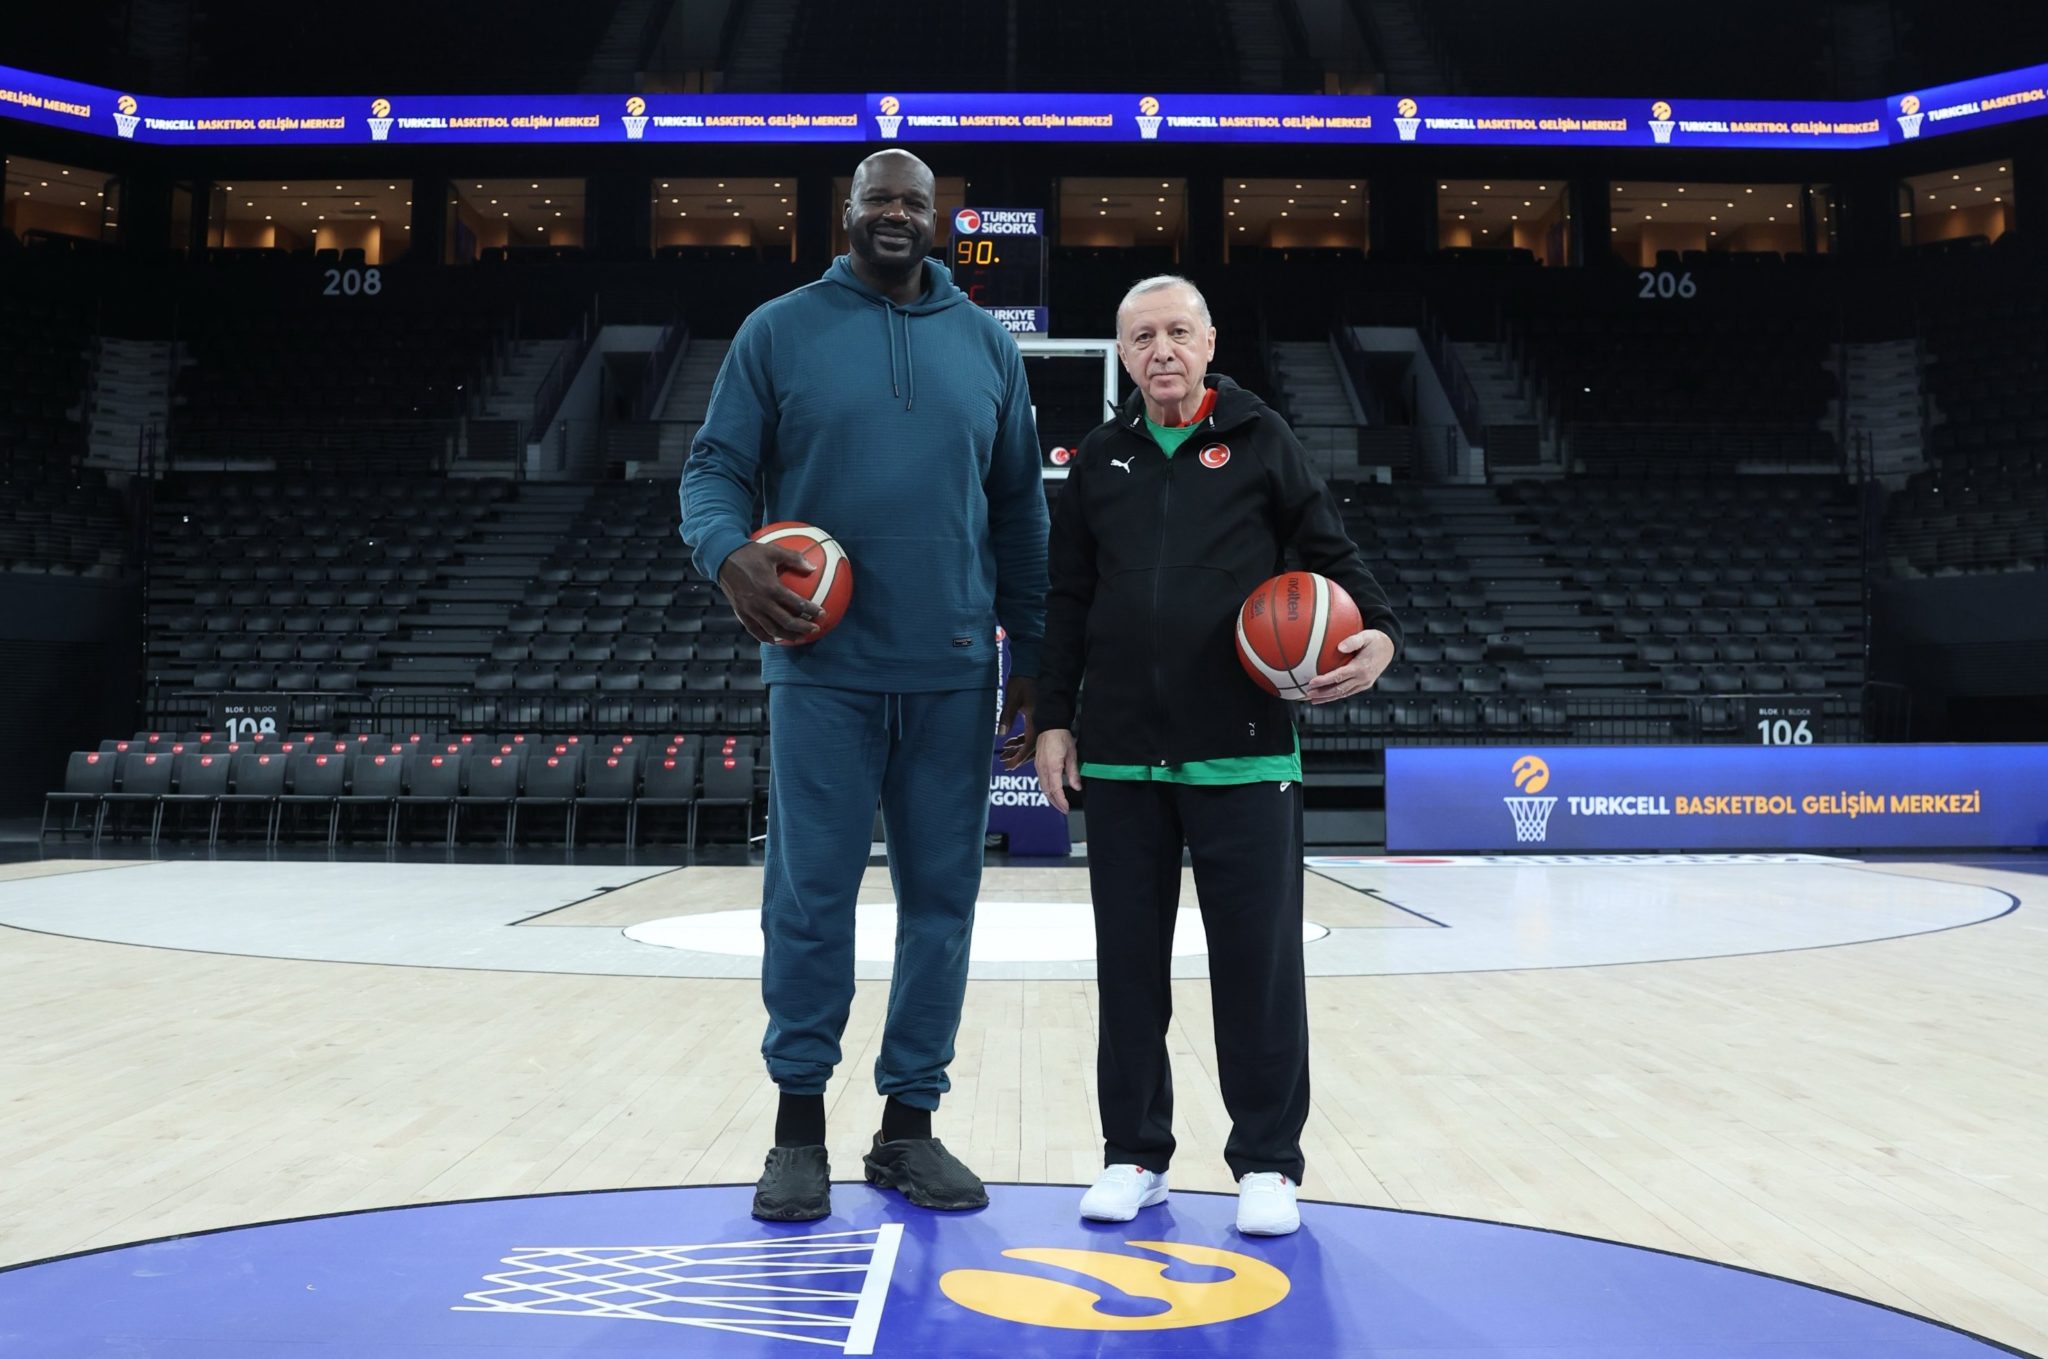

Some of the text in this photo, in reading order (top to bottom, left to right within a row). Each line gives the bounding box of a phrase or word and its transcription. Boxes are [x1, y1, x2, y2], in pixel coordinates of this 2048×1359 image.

[43, 98, 91, 118] MERKEZİ
[1926, 88, 2046, 122] TURKCELL BASKETBOL
[144, 117, 195, 130] TURKCELL
[197, 118, 256, 130] BASKETBOL
[300, 116, 345, 130] MERKEZİ
[397, 117, 448, 129] TURKCELL
[449, 117, 509, 128] BASKETBOL
[553, 115, 600, 128] MERKEZİ
[652, 115, 704, 127] TURKCELL
[705, 115, 766, 127] BASKETBOL
[811, 114, 857, 127] MERKEZİ
[907, 115, 959, 127] TURKCELL
[960, 115, 1021, 127] BASKETBOL
[1066, 114, 1113, 127] MERKEZİ
[1167, 116, 1219, 128] TURKCELL
[1219, 116, 1281, 128] BASKETBOL
[1325, 115, 1372, 129] MERKEZİ
[1424, 118, 1476, 130] TURKCELL
[1477, 118, 1538, 130] BASKETBOL
[1581, 117, 1627, 131] MERKEZİ
[1678, 120, 1730, 133] TURKCELL
[1730, 121, 1790, 133] BASKETBOL
[1833, 118, 1880, 134] MERKEZİ
[323, 268, 382, 296] 208
[1637, 271, 1697, 298] 206
[1287, 577, 1301, 622] molten
[1759, 708, 1811, 716] BLOK BLOCK
[1757, 719, 1814, 746] 106
[1568, 789, 1981, 819] TURKCELL BASKETBOL GELİŞİM MERKEZİ
